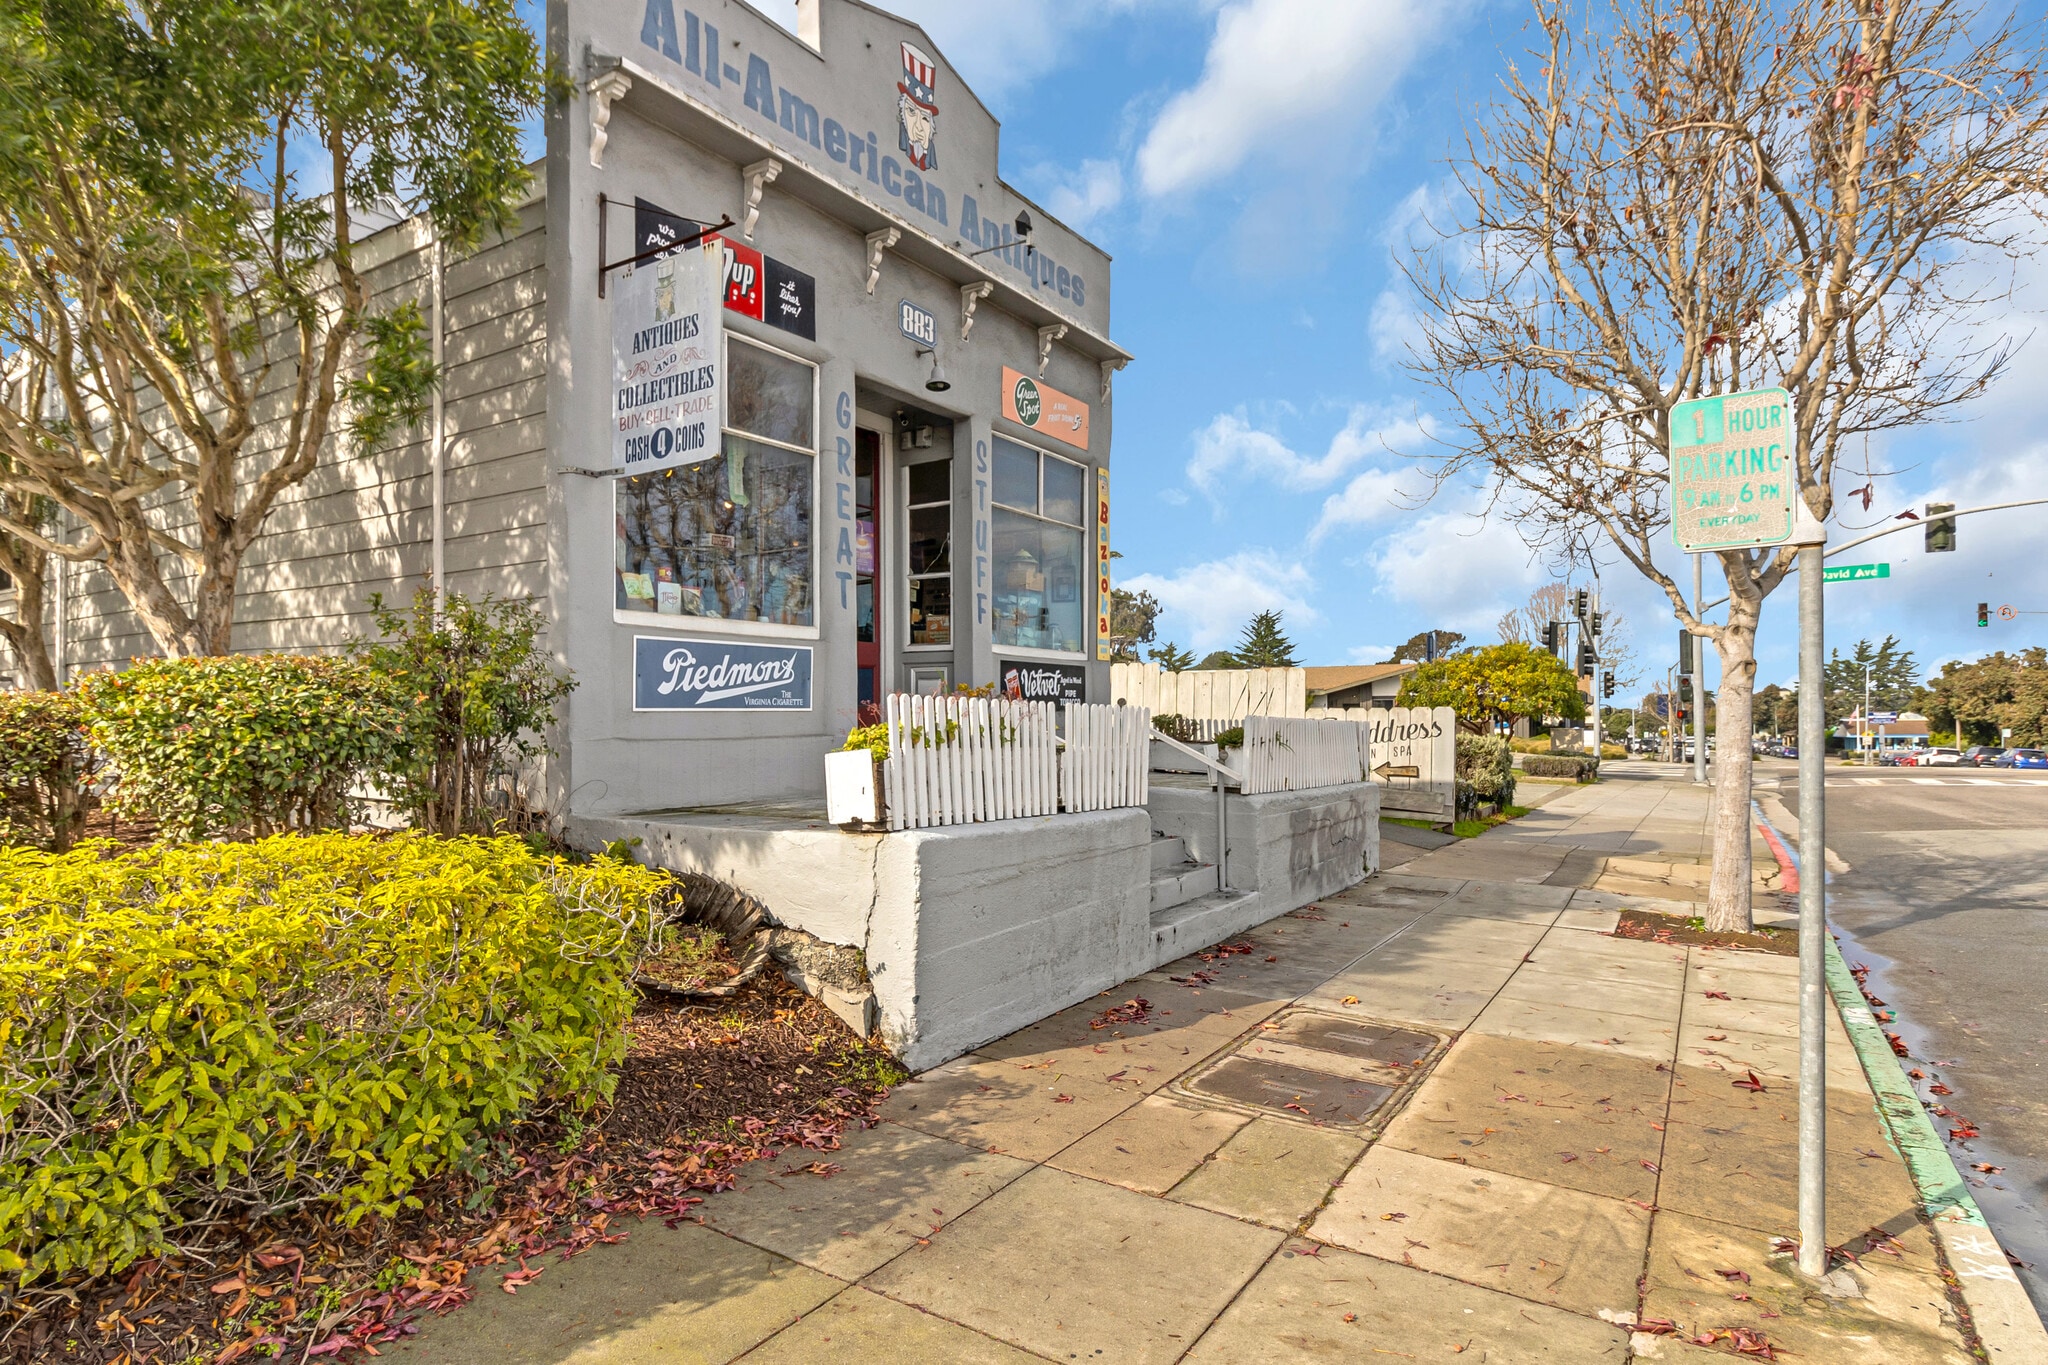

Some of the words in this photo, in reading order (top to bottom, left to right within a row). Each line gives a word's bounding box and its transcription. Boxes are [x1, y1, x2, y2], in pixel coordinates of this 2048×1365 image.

[641, 0, 947, 227] All-American
[959, 194, 1086, 307] Antiques
[658, 223, 676, 239] we
[632, 313, 700, 355] ANTIQUES
[902, 304, 934, 343] 883
[654, 353, 677, 374] AND
[618, 364, 715, 411] COLLECTIBLES
[1016, 381, 1038, 408] Green
[1019, 401, 1040, 420] Spot
[1692, 409, 1706, 443] 1
[1728, 405, 1782, 434] HOUR
[625, 434, 650, 464] CASH
[656, 430, 667, 456] 4
[675, 422, 705, 453] COINS
[1678, 443, 1782, 483] PARKING
[835, 391, 853, 610] GREAT
[1682, 488, 1696, 508] 9
[1700, 491, 1721, 507] AM
[1739, 482, 1754, 503] 6
[1760, 483, 1780, 501] PM
[975, 439, 987, 625] STUFF
[1100, 501, 1109, 634] Bazooka
[1854, 568, 1878, 577] Ave
[657, 648, 798, 702] Piedmont
[1021, 668, 1062, 698] Velvet
[1370, 719, 1442, 744] ddress
[1393, 746, 1412, 757] SPA
